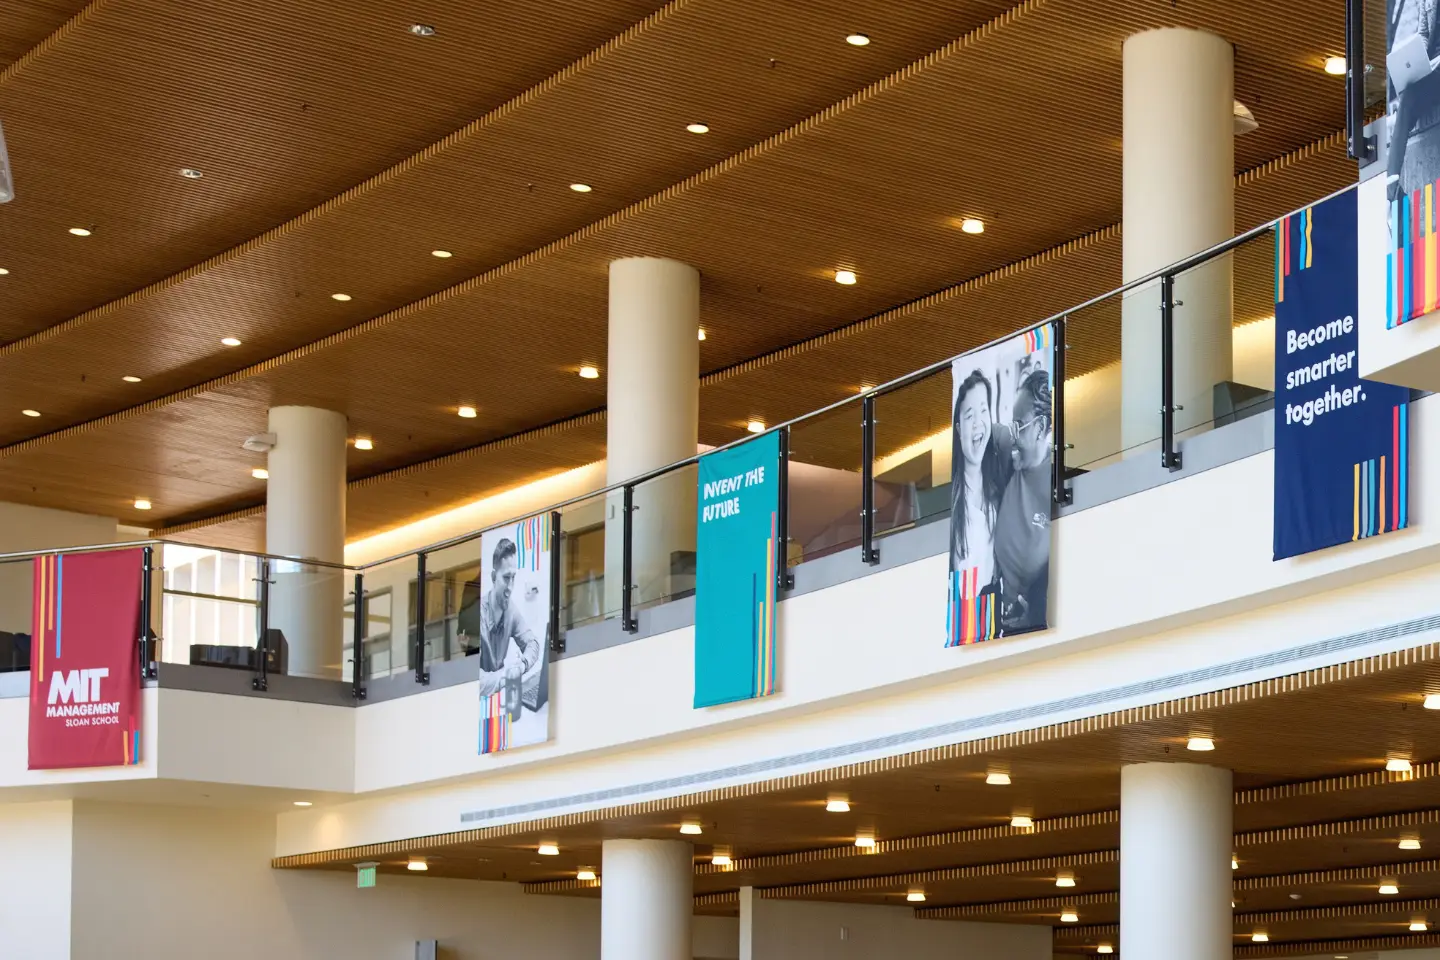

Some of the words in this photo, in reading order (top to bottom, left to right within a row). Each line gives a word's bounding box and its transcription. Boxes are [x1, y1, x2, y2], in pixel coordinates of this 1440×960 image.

[1286, 315, 1354, 354] Become
[1286, 350, 1356, 390] smarter
[1285, 384, 1367, 426] together.
[744, 466, 765, 487] THE
[702, 497, 740, 523] FUTURE
[47, 667, 109, 705] MIT
[46, 701, 120, 718] MANAGEMENT
[65, 718, 90, 727] SLOAN
[91, 716, 119, 726] SCHOOL
